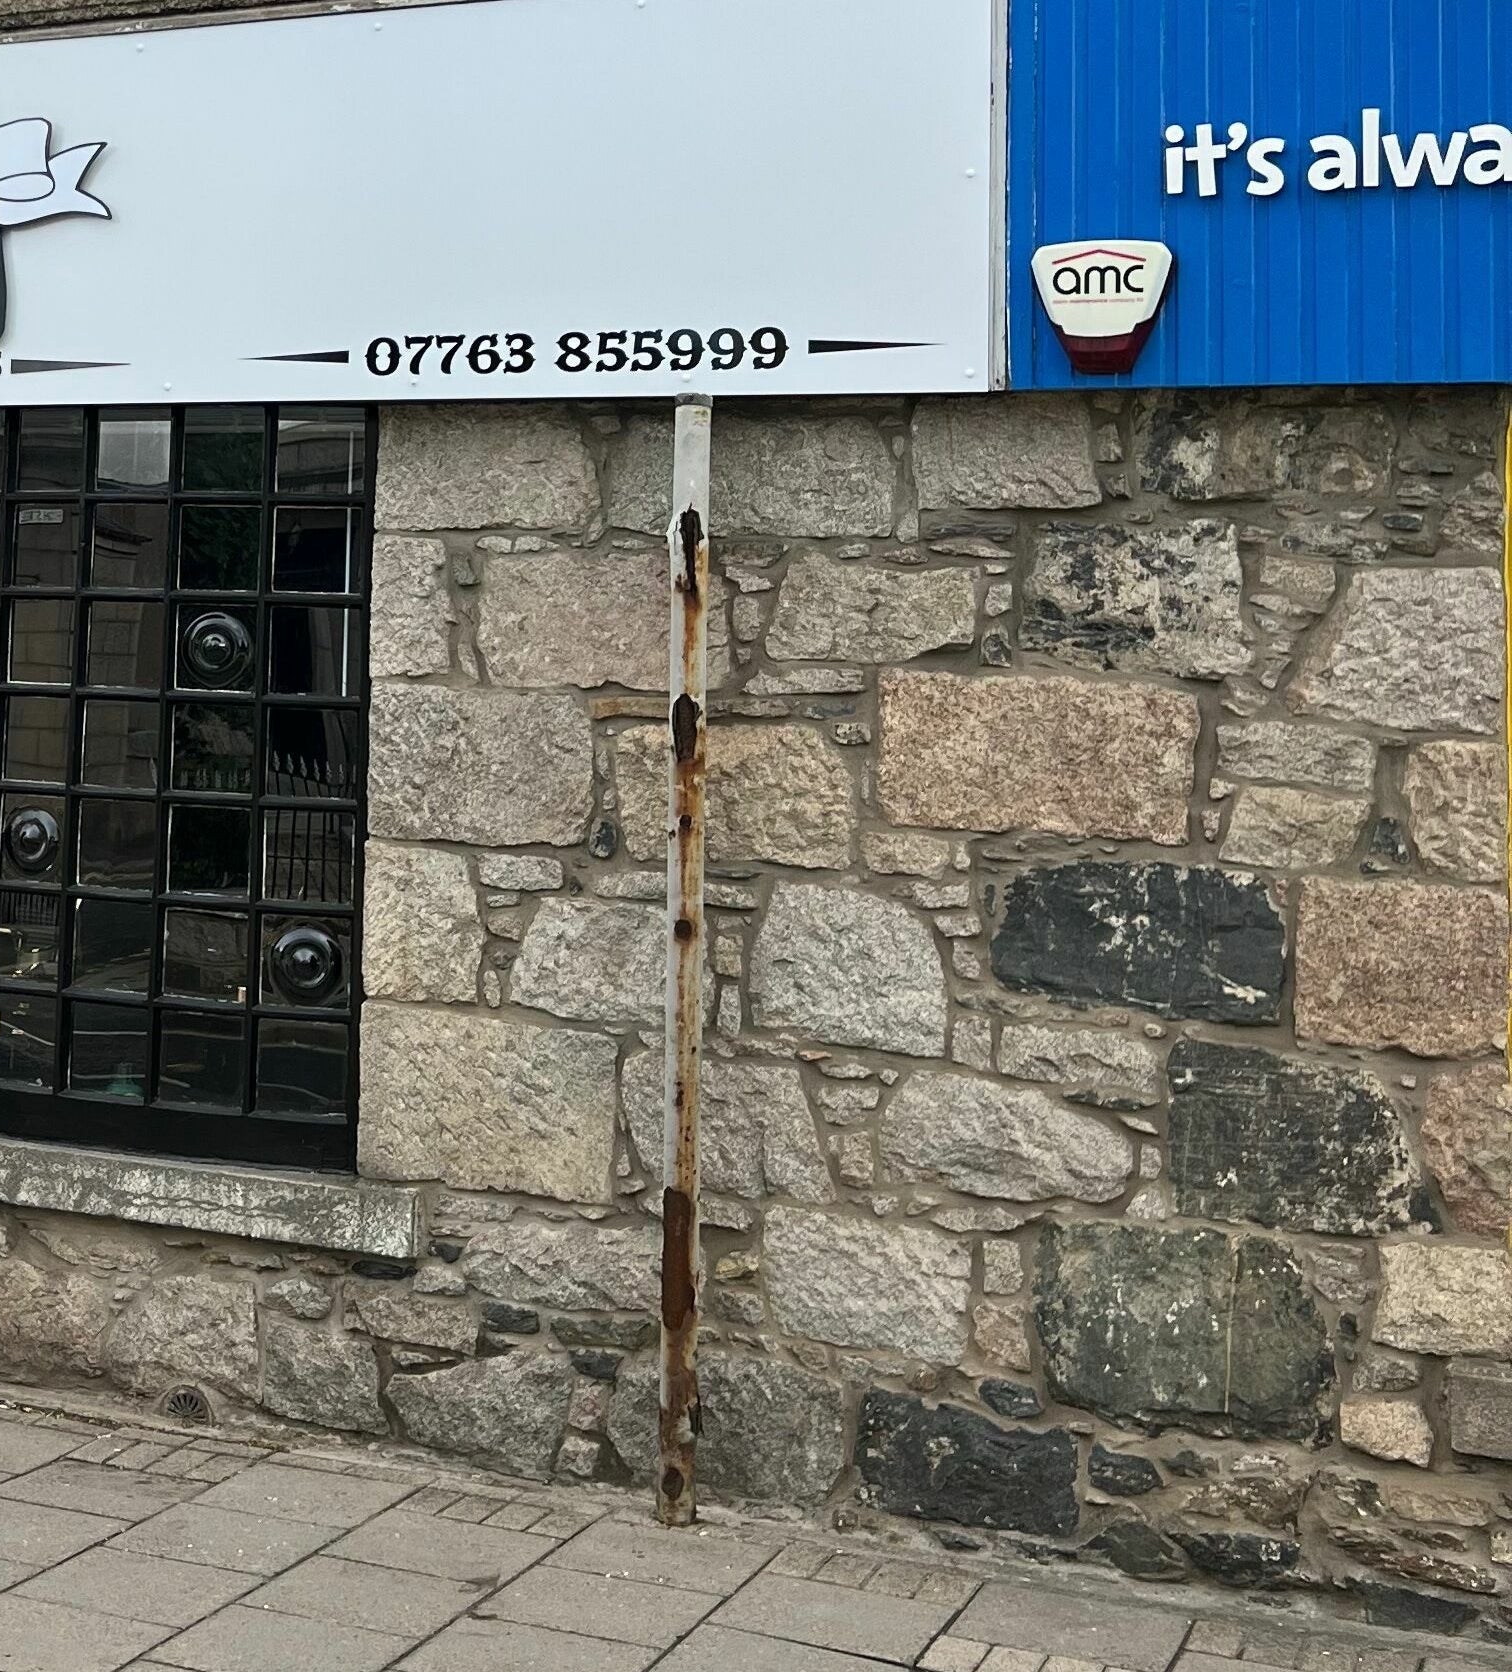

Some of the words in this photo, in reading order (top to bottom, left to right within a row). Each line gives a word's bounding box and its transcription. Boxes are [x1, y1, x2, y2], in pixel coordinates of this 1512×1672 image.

[1164, 121, 1286, 197] it's
[1052, 264, 1145, 296] amc
[364, 332, 537, 377] 07763
[553, 326, 790, 373] 855999
